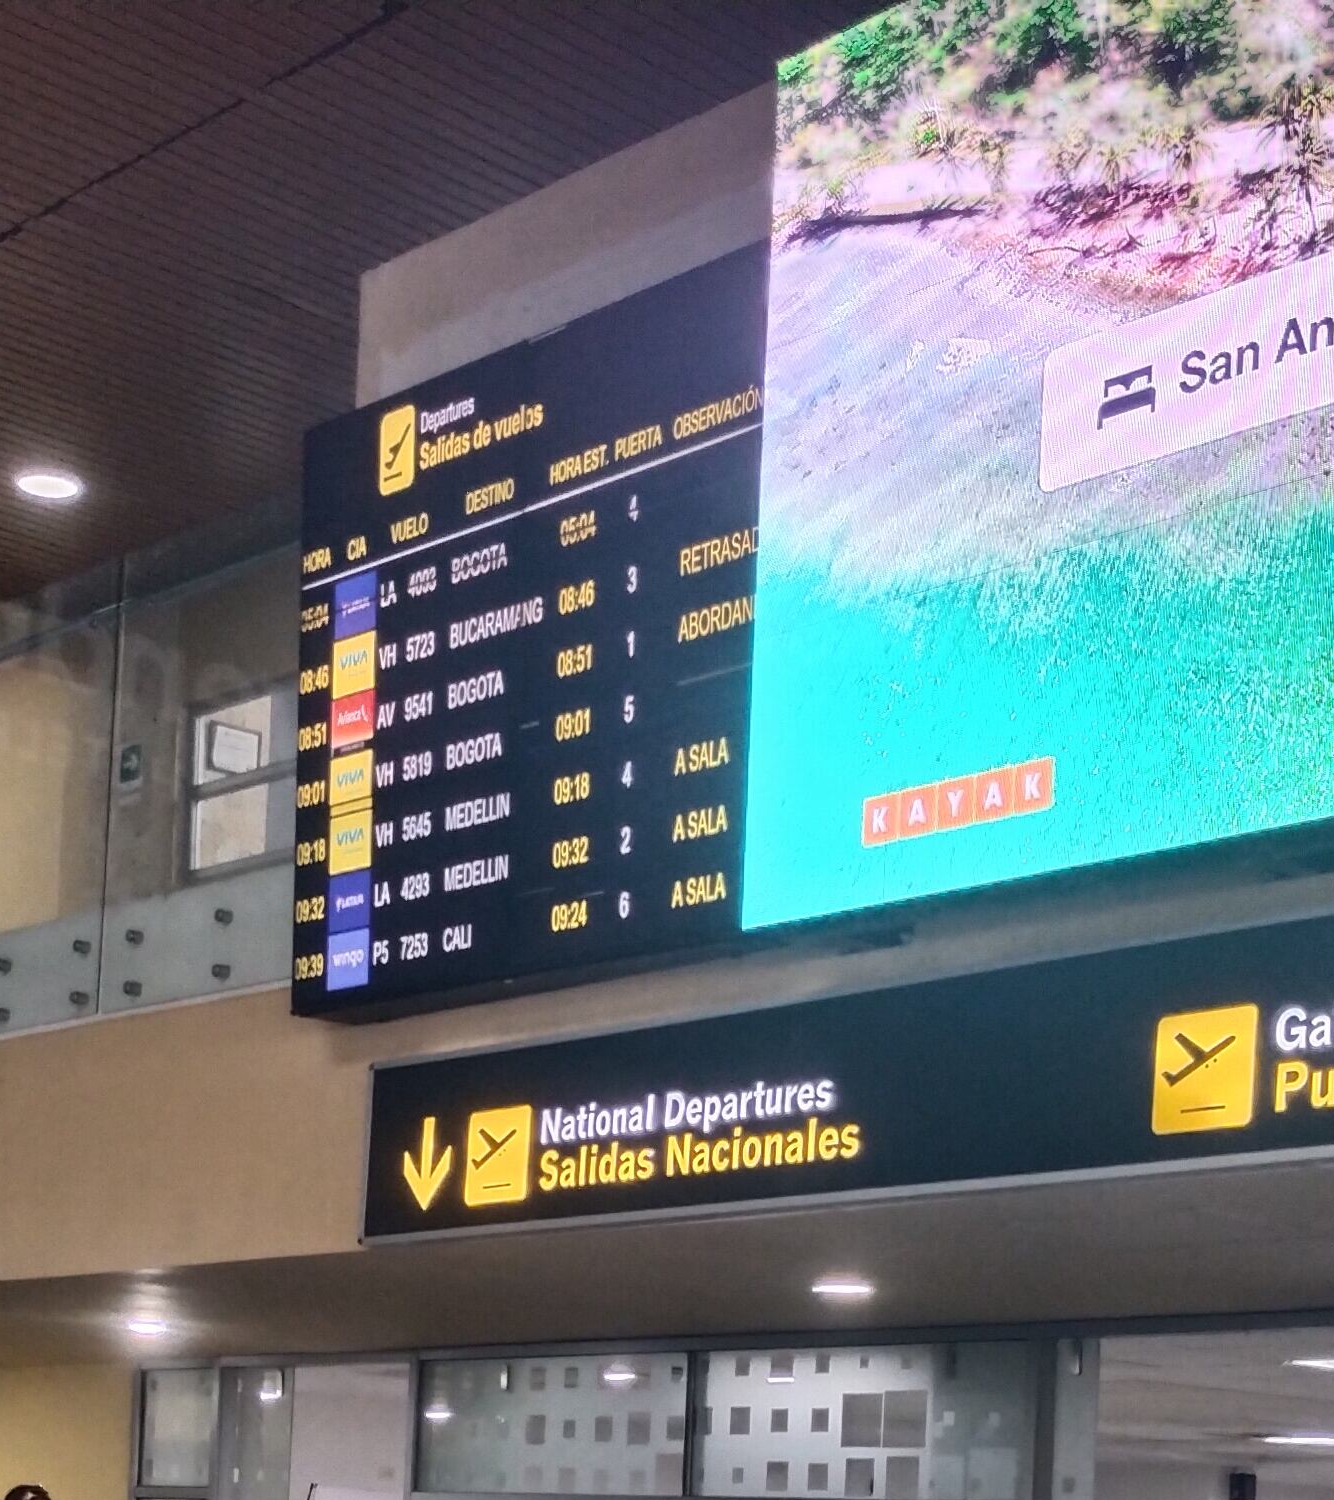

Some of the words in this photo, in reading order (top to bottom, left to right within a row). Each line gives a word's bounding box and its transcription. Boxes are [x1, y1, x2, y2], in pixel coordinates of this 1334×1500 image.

[421, 397, 475, 434] Departures
[1178, 340, 1260, 394] San
[420, 431, 470, 470] Salidas
[473, 420, 491, 449] de
[494, 403, 543, 442] vuelos
[303, 547, 332, 575] HORA
[347, 536, 366, 561] CIA
[391, 512, 429, 544] VUELO
[466, 478, 514, 515] DESTINO
[550, 455, 581, 486] HORA
[582, 445, 609, 474] EST.
[615, 424, 663, 460] PUERTA
[380, 581, 397, 608] LA
[628, 494, 638, 522] 4
[300, 665, 329, 695] 08:46
[340, 650, 368, 670] VIVA
[379, 643, 397, 670] VH
[406, 631, 435, 663] 5723
[450, 596, 544, 649] BUCARAMANG
[559, 579, 596, 616] 08:46
[627, 566, 637, 594] 3
[298, 722, 327, 752] 08:51
[377, 702, 395, 730] AV
[404, 691, 433, 722] 9541
[448, 670, 504, 710] BOGOTA
[557, 644, 593, 679] 08:51
[626, 631, 636, 658] 1
[297, 780, 326, 808] 09:01
[337, 769, 364, 787] VIVA
[376, 761, 394, 788] VH
[403, 751, 432, 782] 5819
[446, 732, 502, 771] BOGOTA
[555, 707, 591, 743] 09:01
[624, 694, 635, 724] 5
[297, 838, 325, 866] 09:18
[337, 827, 364, 845] VIVA
[376, 821, 394, 848] VH
[402, 812, 431, 842] 5645
[445, 792, 510, 832] MEDELLIN
[554, 772, 590, 806] 09:18
[621, 761, 633, 788] 4
[674, 748, 686, 776] A
[689, 736, 729, 772] SALA
[872, 772, 1041, 833] KAYAK
[296, 896, 325, 923] 09:32
[374, 883, 390, 908] LA
[401, 872, 430, 901] 4293
[444, 854, 509, 892] MEDELLIN
[552, 836, 589, 868] 09:32
[620, 826, 631, 854] 2
[673, 813, 684, 843] A
[689, 804, 727, 839] SALA
[295, 953, 324, 980] 09:39
[372, 940, 389, 966] P5
[400, 933, 428, 961] 7253
[443, 924, 472, 952] CALI
[552, 900, 587, 932] 09:24
[619, 891, 630, 919] 6
[672, 880, 682, 909] A
[686, 872, 726, 906] SALA
[539, 1142, 655, 1192] Salidas
[666, 1117, 861, 1177] Nacionales
[540, 1093, 655, 1145] National
[664, 1078, 835, 1133] Departures
